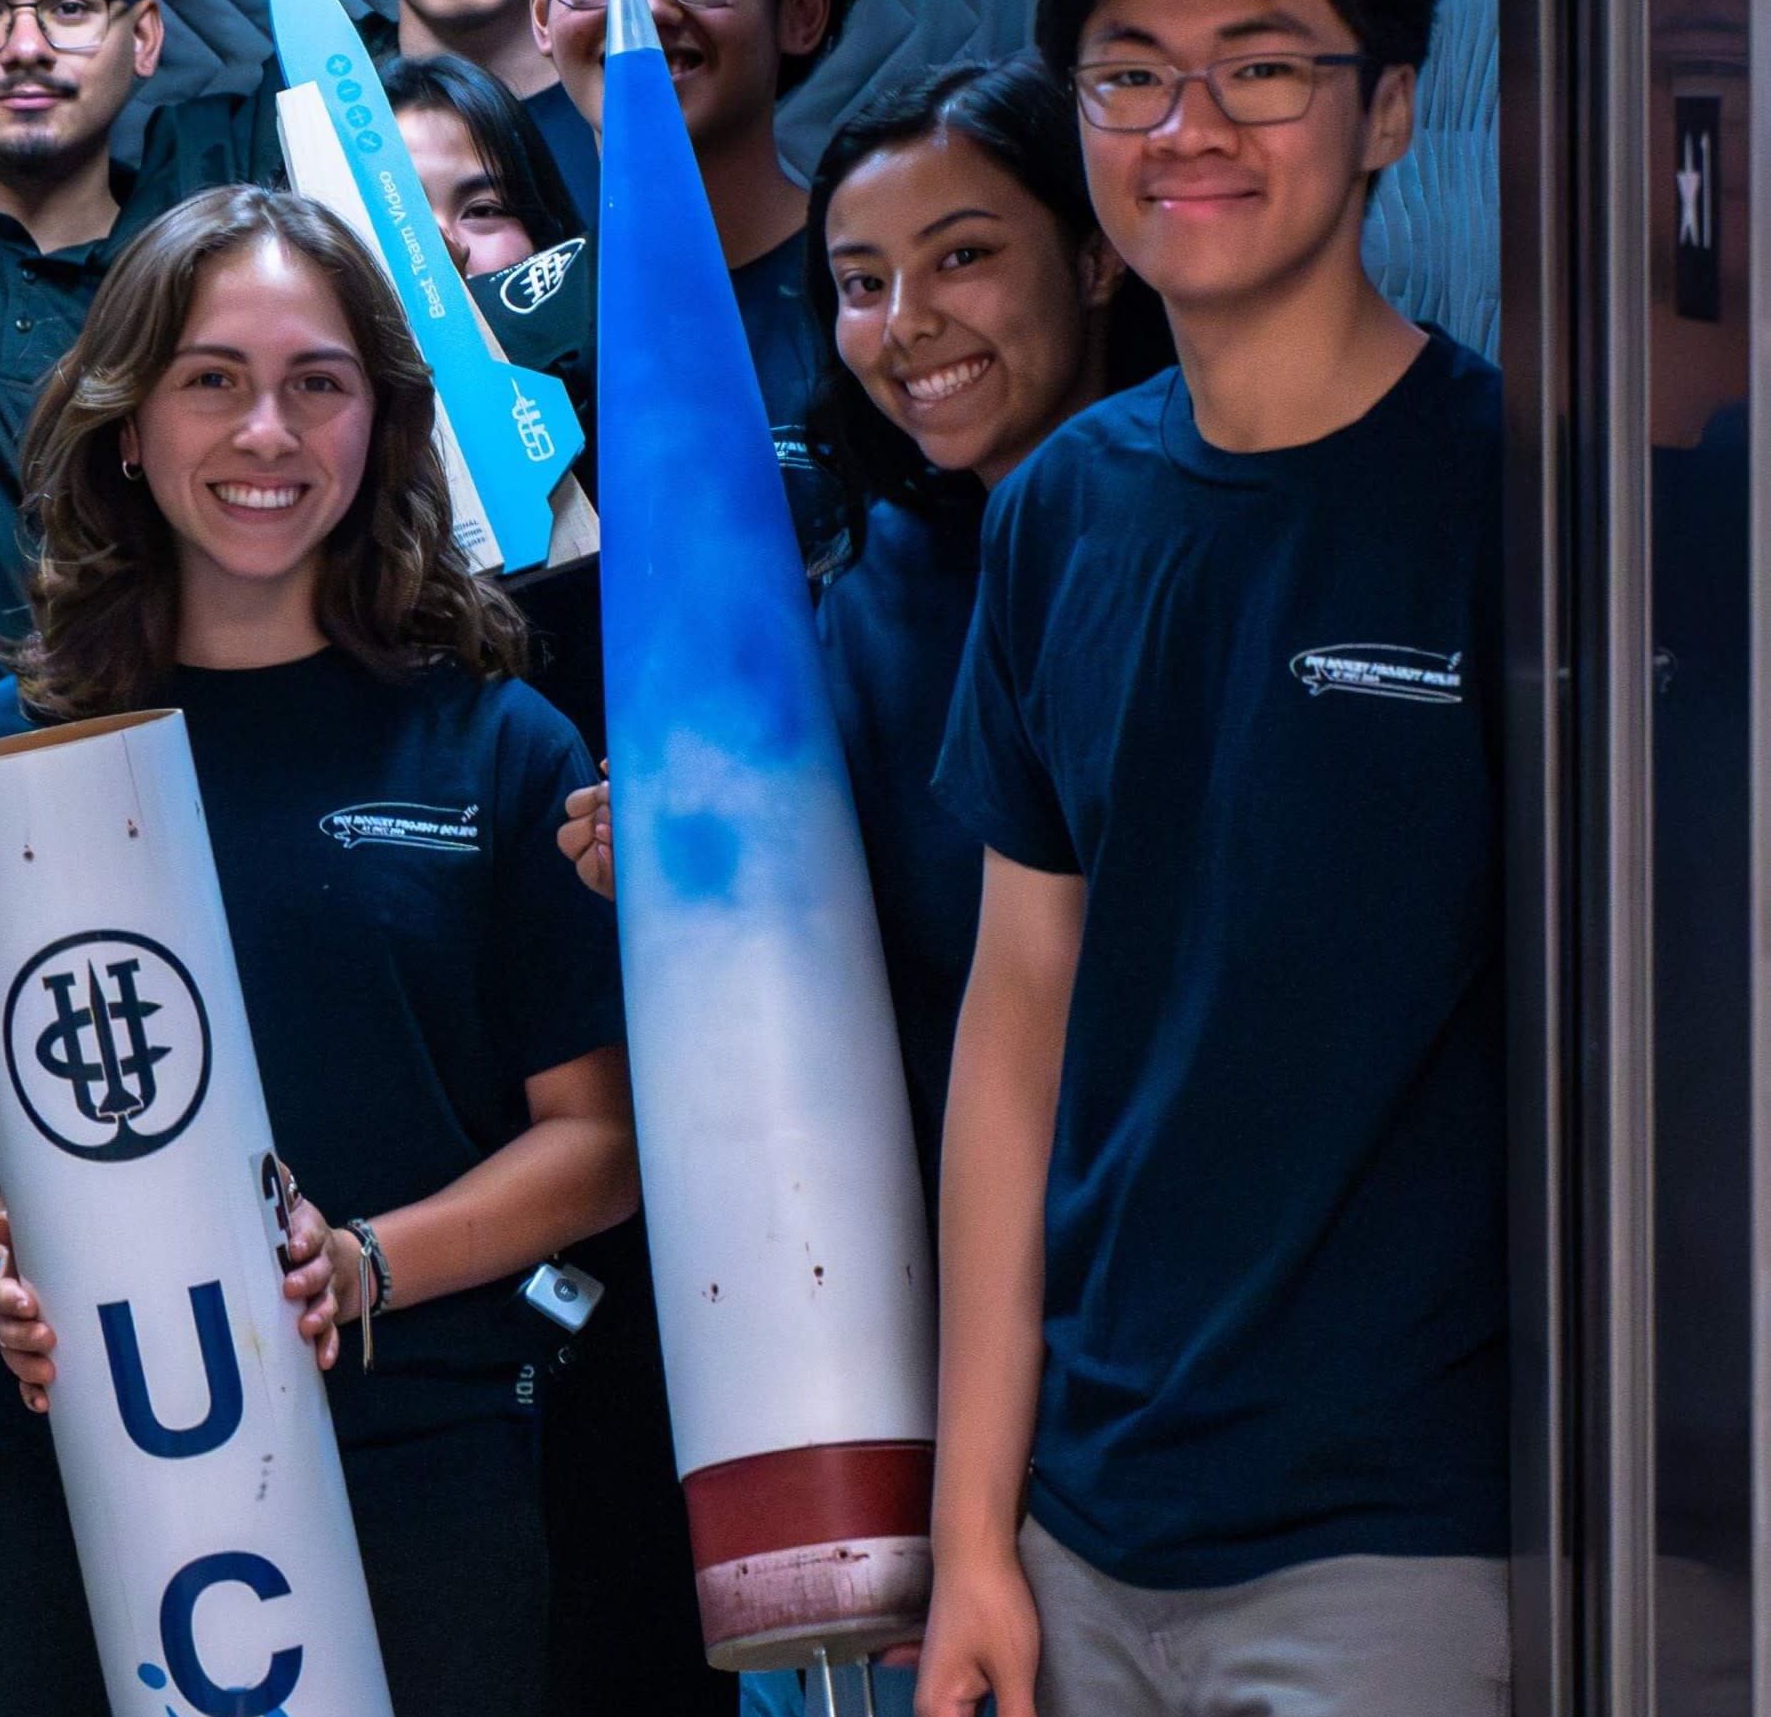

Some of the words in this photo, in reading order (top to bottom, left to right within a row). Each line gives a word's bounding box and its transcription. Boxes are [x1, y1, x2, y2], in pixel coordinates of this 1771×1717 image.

[379, 171, 407, 224] Video
[401, 226, 427, 276] Team
[420, 276, 446, 320] Best
